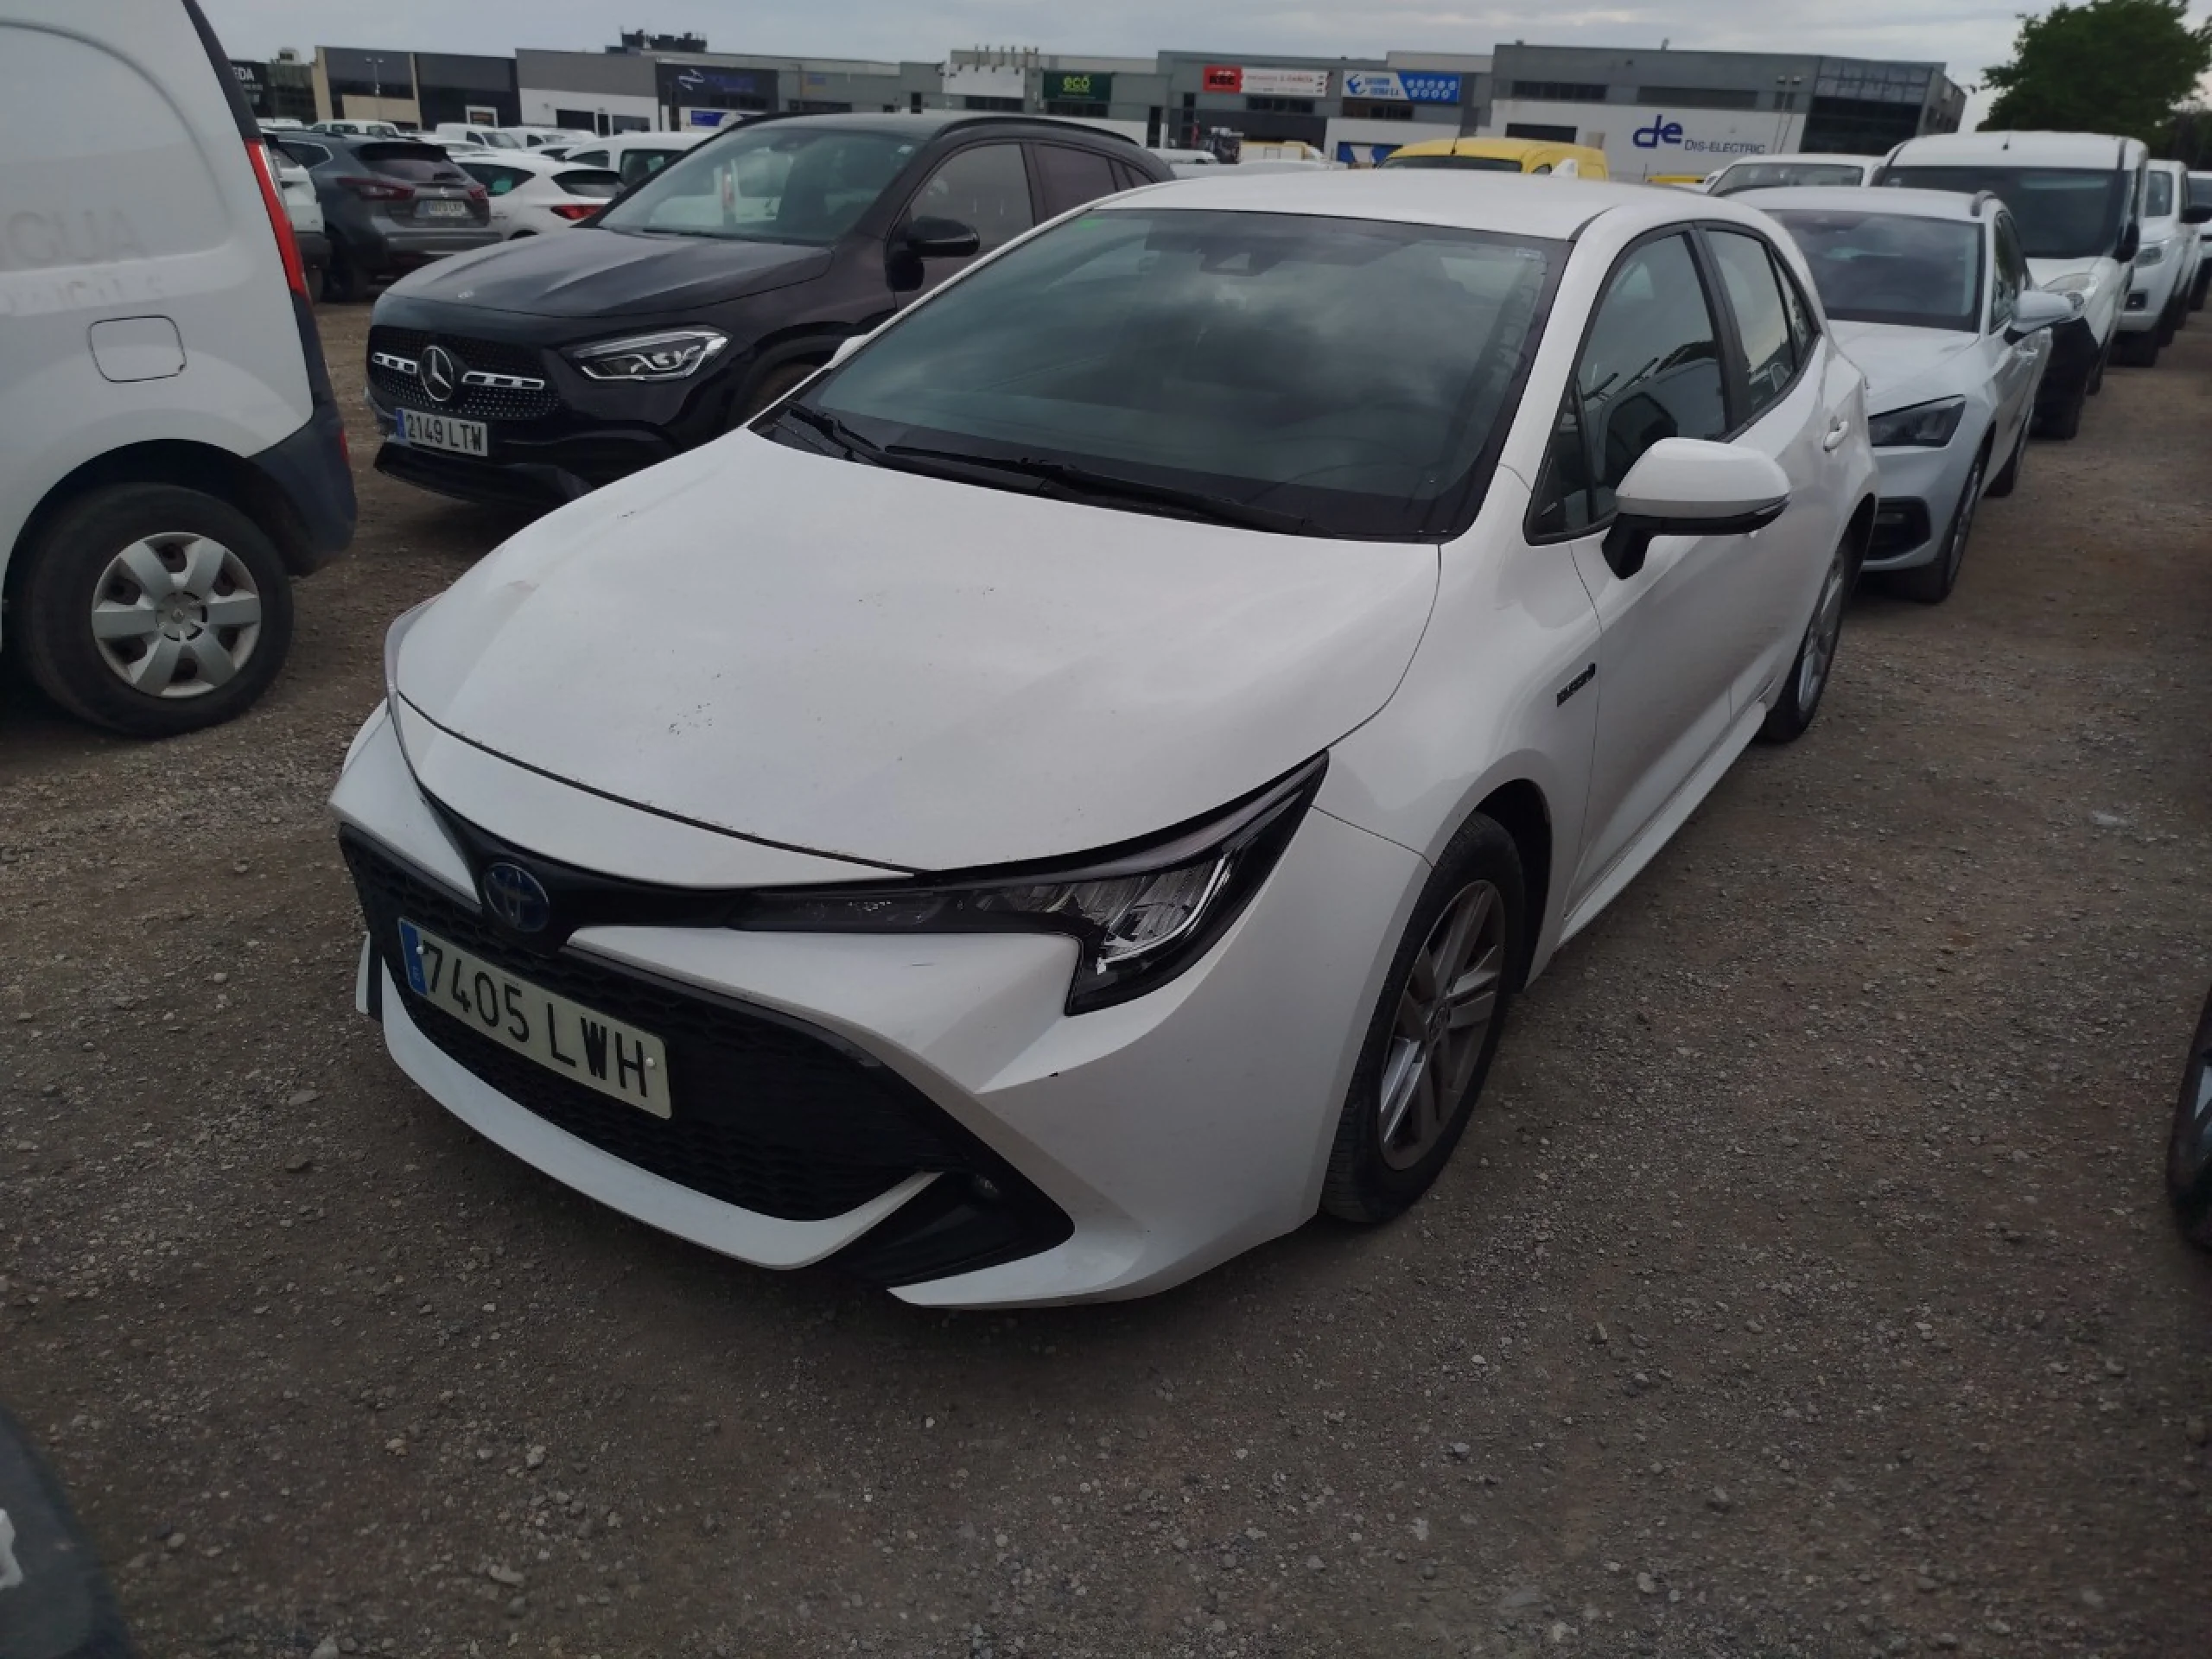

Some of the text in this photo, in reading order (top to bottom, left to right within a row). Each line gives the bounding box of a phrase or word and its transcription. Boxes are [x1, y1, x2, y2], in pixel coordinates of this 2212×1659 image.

[405, 414, 483, 453] 2149 LTW
[423, 939, 647, 1098] 7405 LWH
